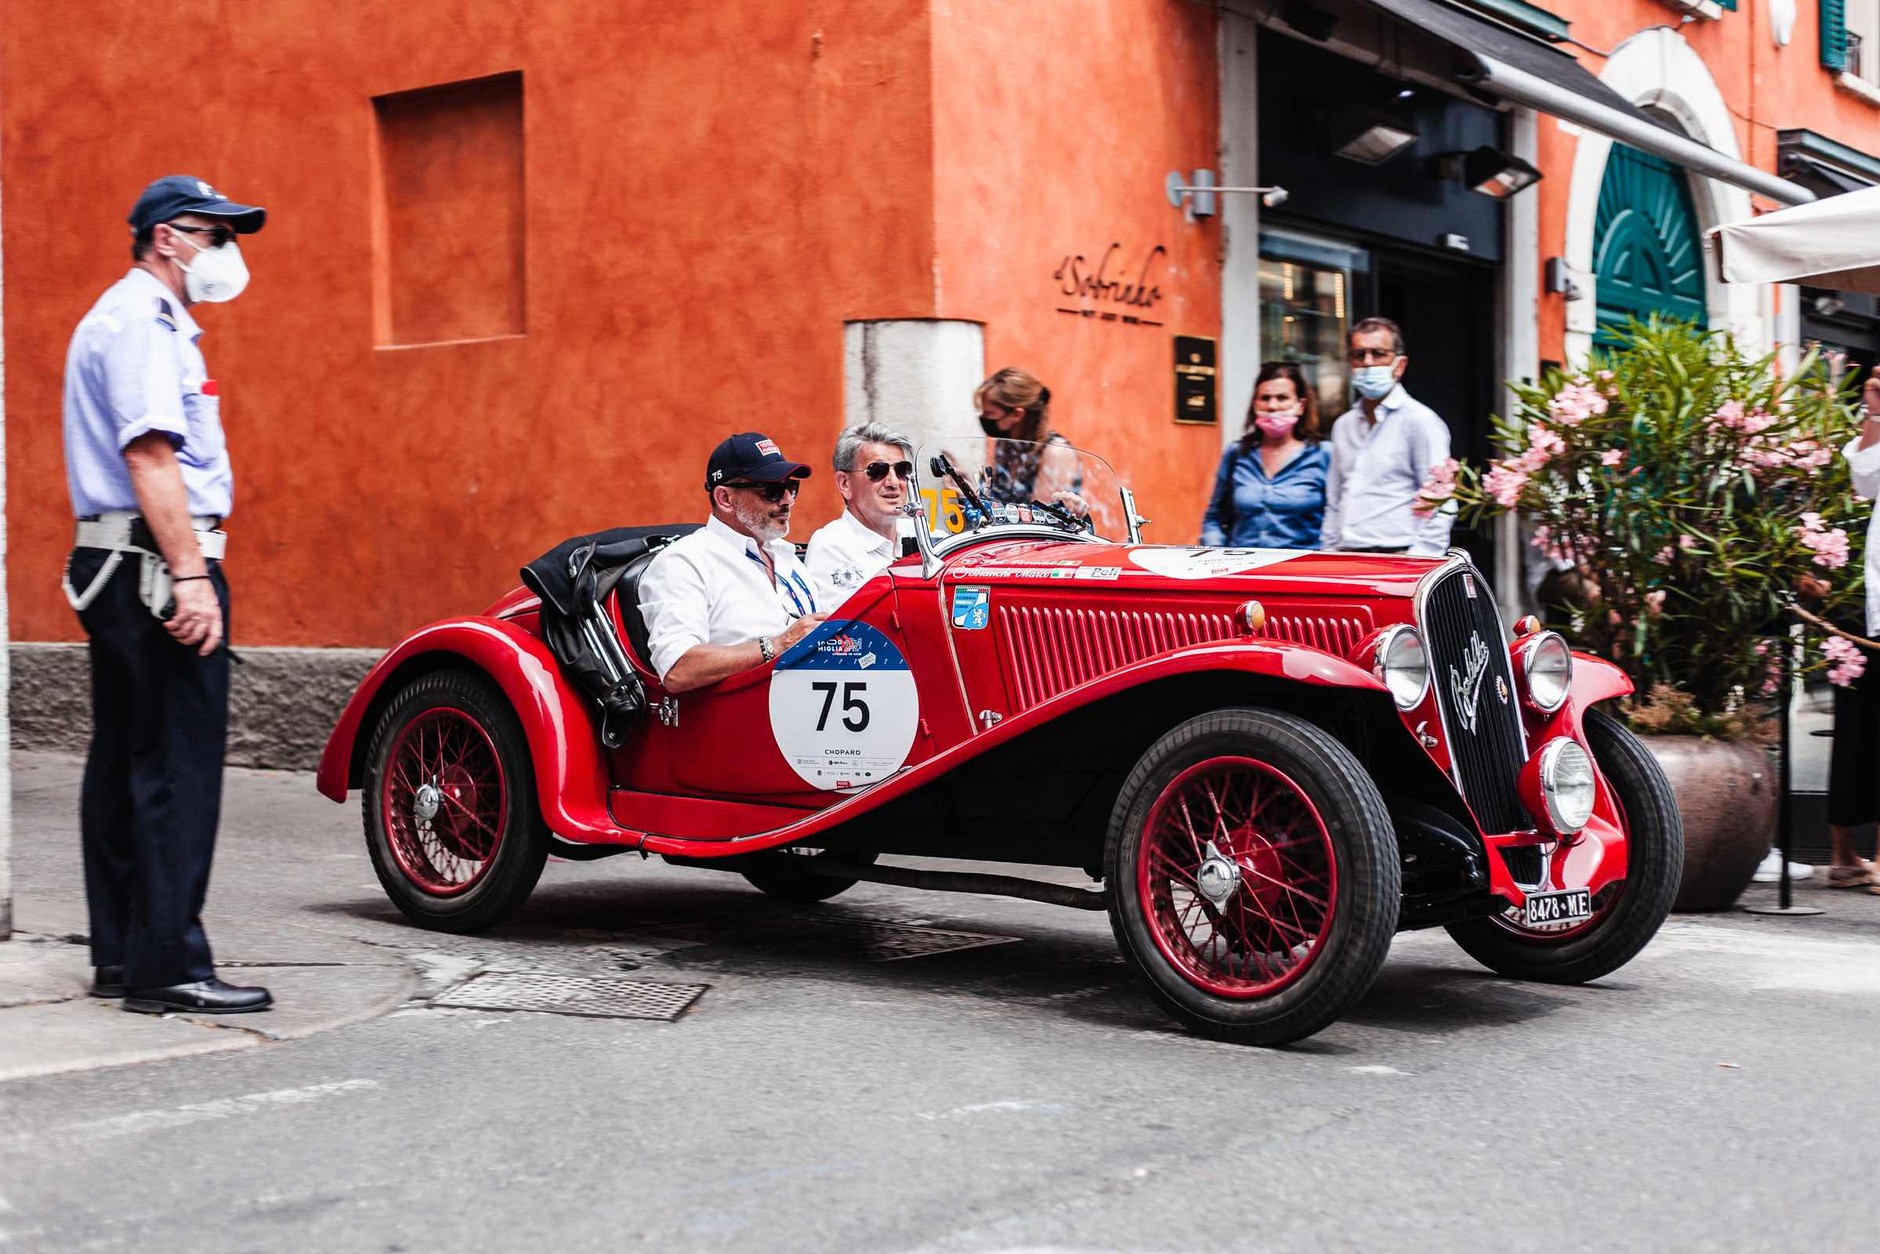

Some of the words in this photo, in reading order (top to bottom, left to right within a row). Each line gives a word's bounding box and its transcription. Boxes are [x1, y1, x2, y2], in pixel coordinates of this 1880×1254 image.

[711, 470, 723, 481] 75
[919, 489, 965, 534] 75
[812, 682, 870, 732] 75
